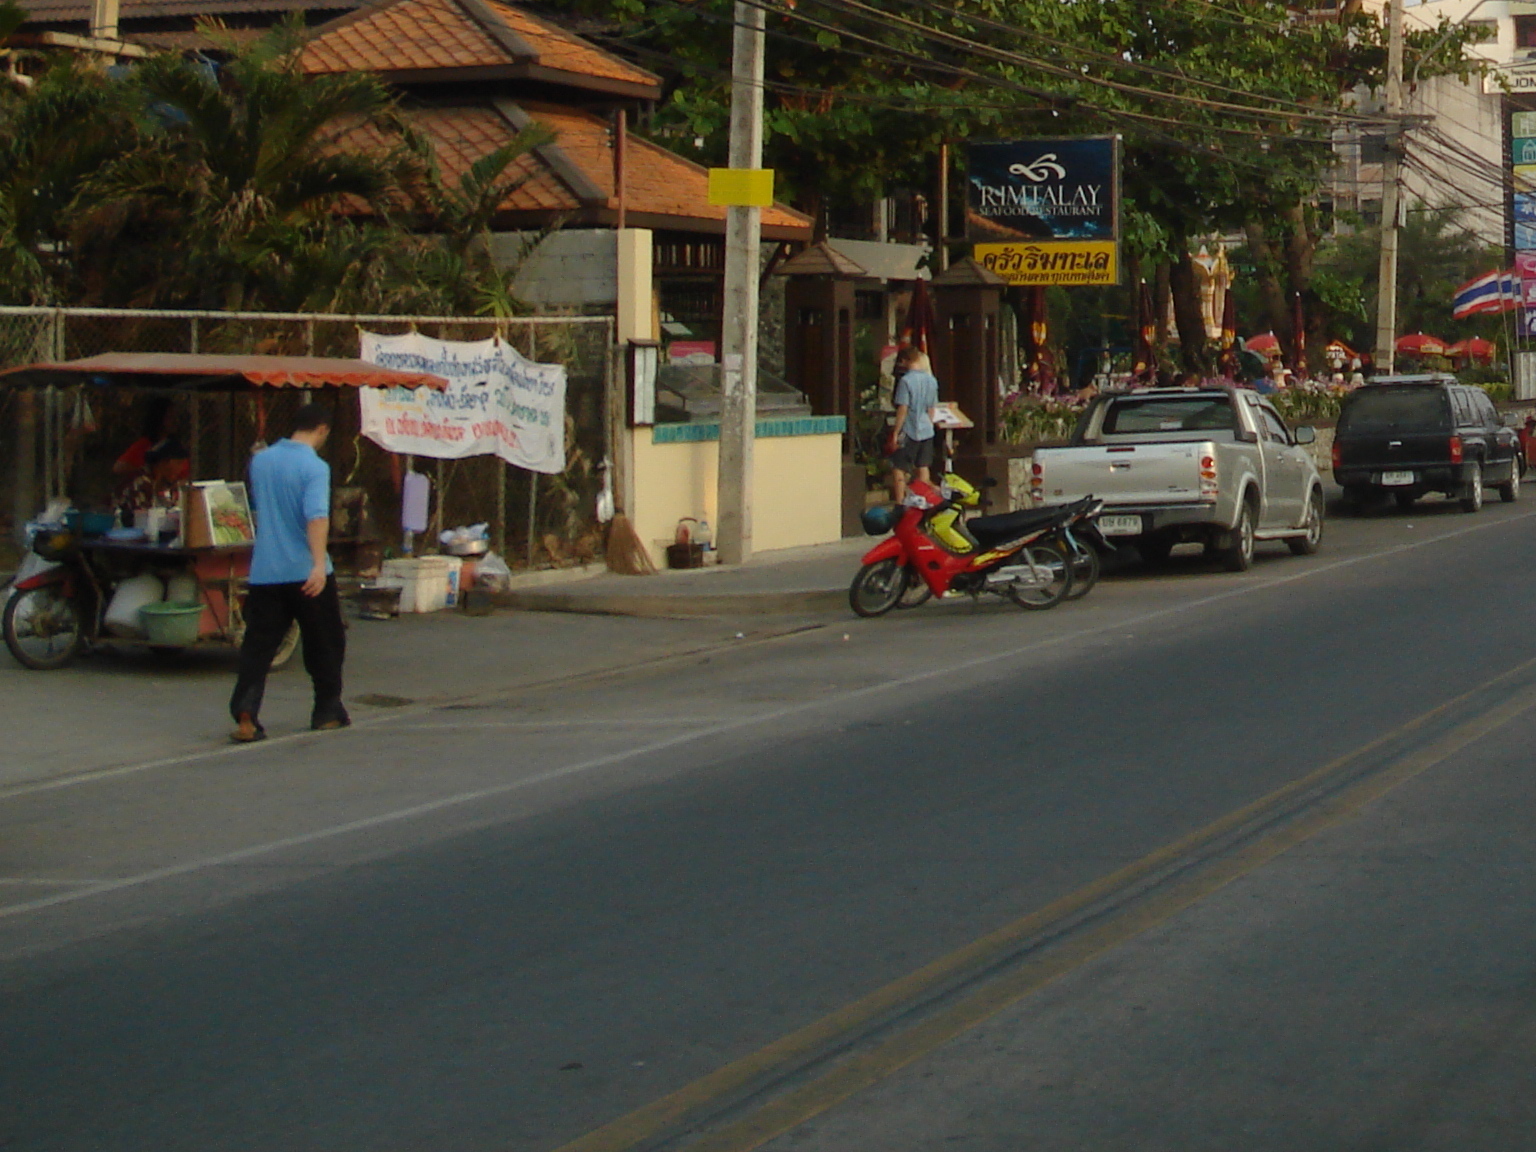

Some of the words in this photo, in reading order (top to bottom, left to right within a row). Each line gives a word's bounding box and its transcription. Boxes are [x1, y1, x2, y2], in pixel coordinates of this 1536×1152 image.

[980, 184, 1102, 206] RIMTALAY
[979, 206, 1031, 215] SEAFOOD
[1033, 206, 1102, 215] RESTAURANT
